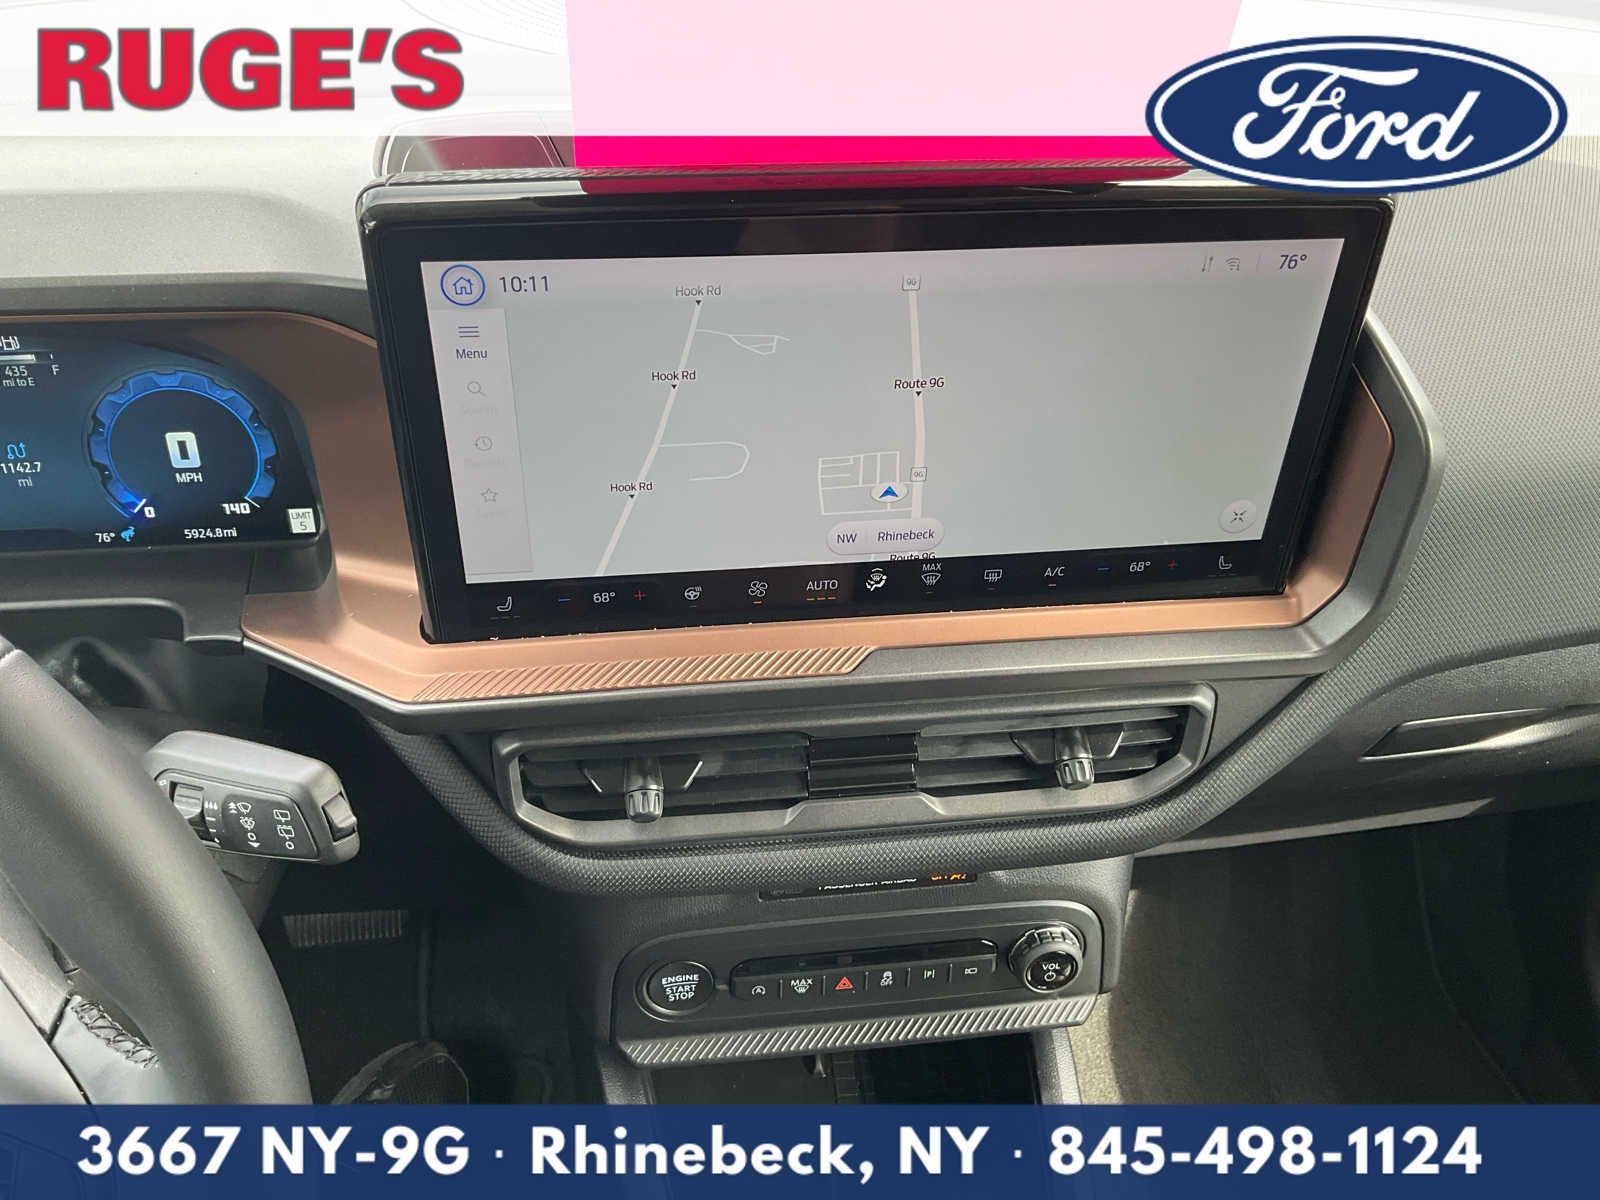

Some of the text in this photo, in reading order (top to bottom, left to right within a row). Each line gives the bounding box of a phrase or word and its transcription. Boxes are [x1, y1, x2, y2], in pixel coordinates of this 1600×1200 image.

[1279, 253, 1307, 270] 76°
[498, 275, 549, 292] 10:11
[675, 285, 721, 297] Hook Rd
[455, 347, 488, 360] Menu
[5, 365, 28, 377] 435
[51, 363, 60, 376] F
[2, 377, 36, 387] mi to E
[651, 370, 696, 382] Hook Rd
[894, 376, 945, 390] Route 9G
[165, 431, 201, 469] 0
[0, 461, 41, 474] 1142.7
[17, 476, 33, 487] mi
[176, 472, 203, 484] MPH
[610, 481, 653, 493] Hook Rd
[144, 506, 155, 518] 0
[222, 502, 251, 515] 140
[291, 511, 312, 519] LIMIT
[299, 520, 308, 531] 5
[95, 531, 116, 544] 76°
[836, 532, 857, 544] NW
[877, 529, 935, 542] Rhinebeck
[922, 562, 942, 571] MAX
[1044, 566, 1065, 578] A/C
[1130, 561, 1151, 573] 68°
[806, 579, 839, 591] AUTO
[593, 591, 616, 604] 68°
[1042, 962, 1061, 970] VOL
[661, 974, 700, 985] ENGINE
[791, 978, 813, 987] MAX
[665, 984, 697, 995] START
[668, 991, 695, 1002] STOP
